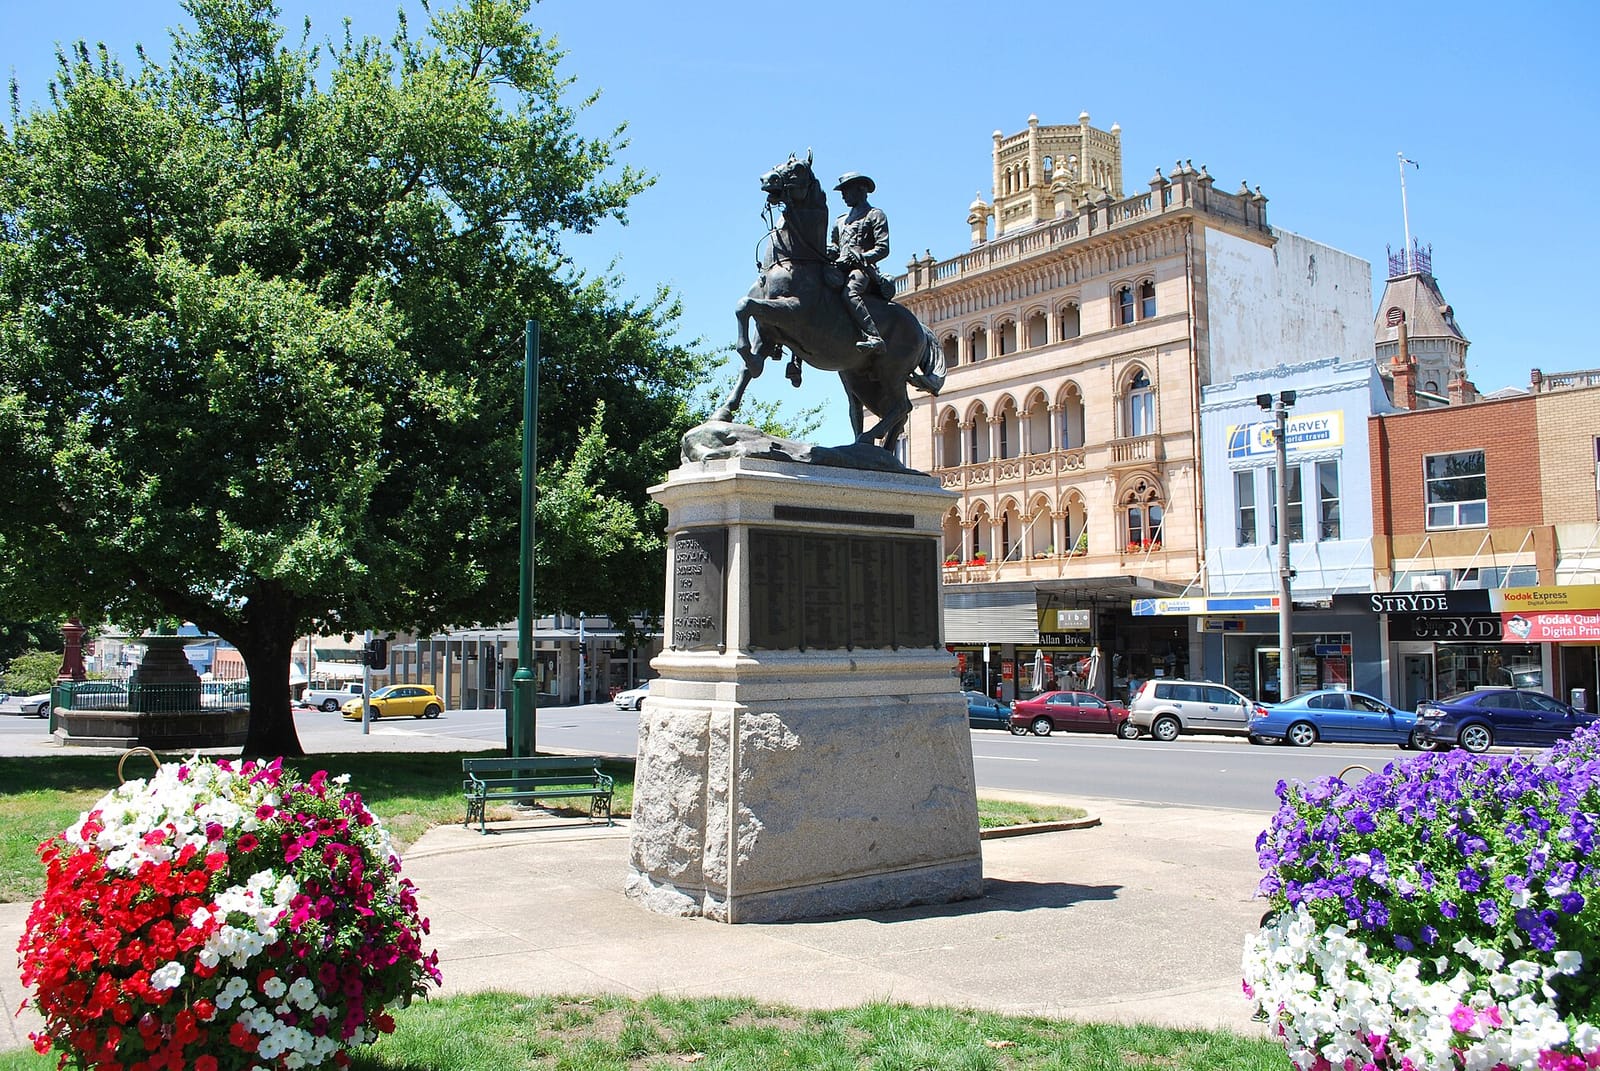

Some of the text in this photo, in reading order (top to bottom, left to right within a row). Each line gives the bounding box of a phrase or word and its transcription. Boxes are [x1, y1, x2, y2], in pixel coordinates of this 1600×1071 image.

[1286, 431, 1328, 443] orld travel
[1504, 591, 1567, 601] Kodak Express
[1538, 614, 1572, 625] Kodak
[1542, 625, 1576, 638] Digital
[1040, 634, 1060, 645] Allan
